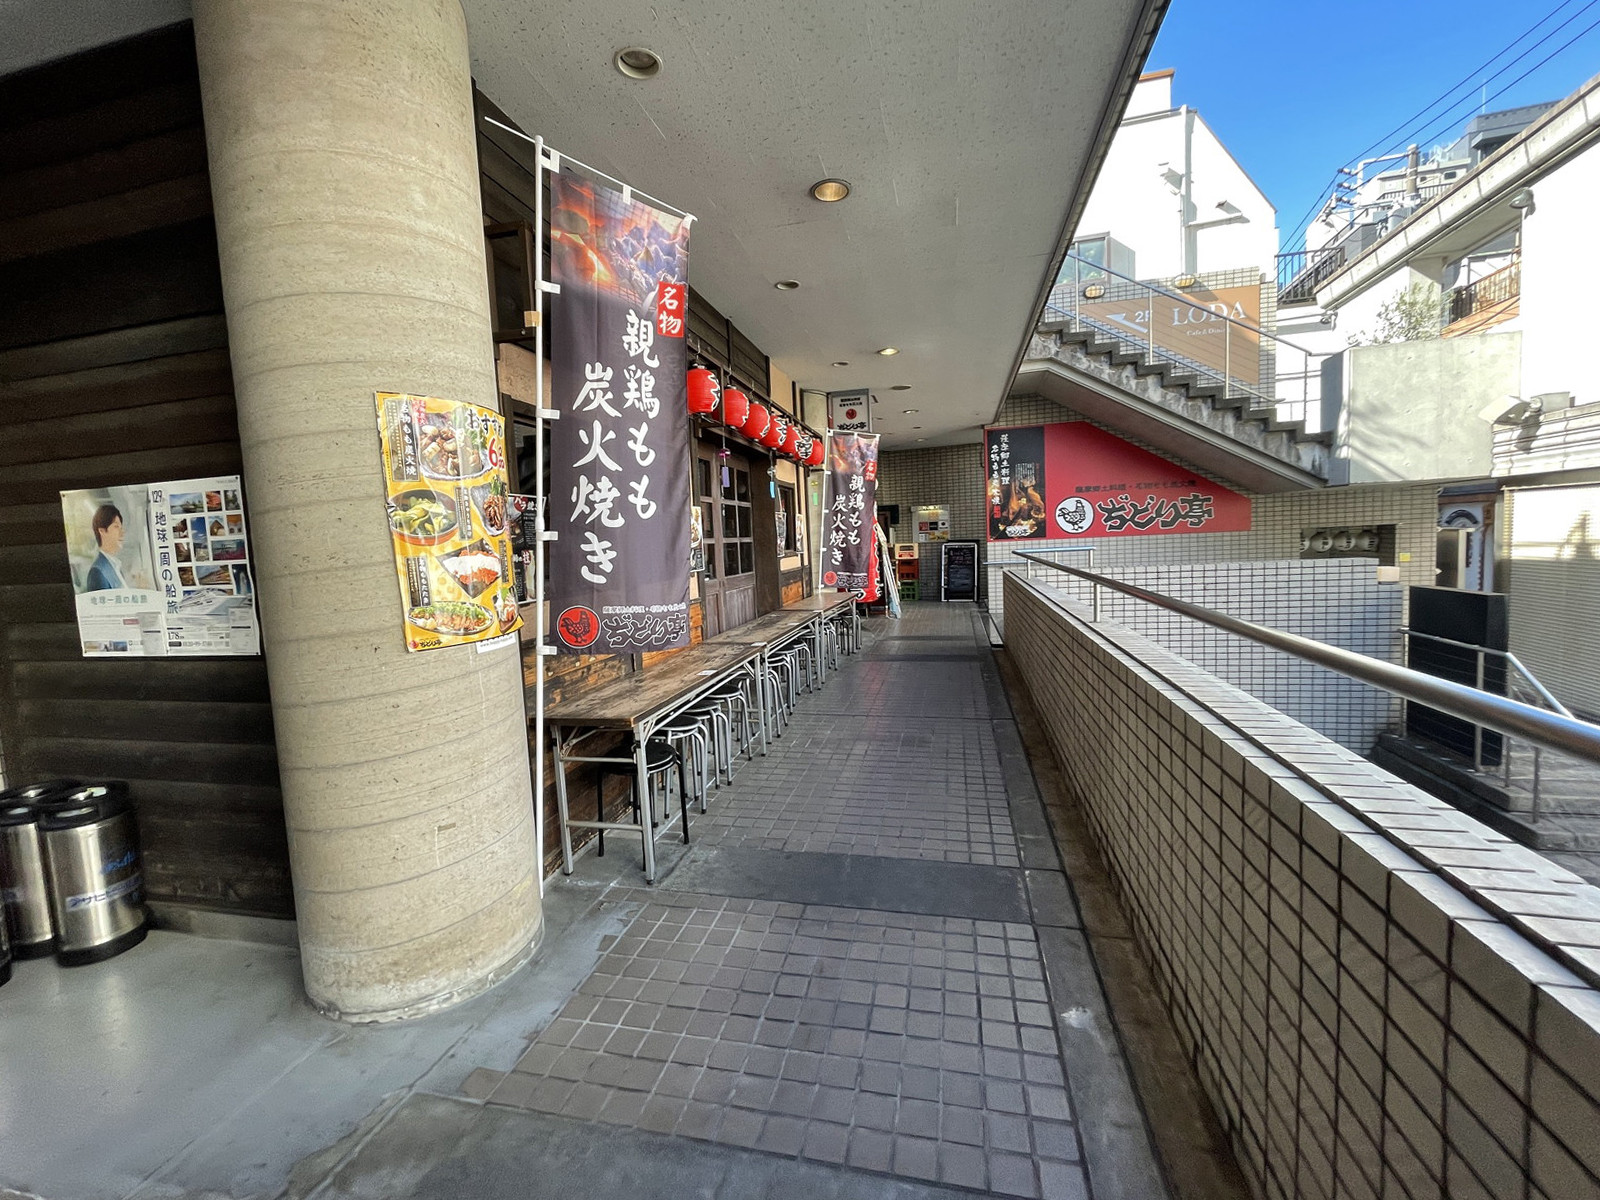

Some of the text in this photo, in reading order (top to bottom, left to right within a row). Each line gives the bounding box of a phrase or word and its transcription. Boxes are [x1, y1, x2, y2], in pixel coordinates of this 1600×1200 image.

[659, 286, 683, 335] 名物
[1172, 301, 1247, 326] LODA
[466, 408, 503, 438] おすすめ
[621, 308, 661, 520] 親鶏もも
[569, 361, 626, 585] 炭火焼き
[829, 494, 849, 565] 炭火焼き
[848, 474, 866, 545] 親鶏もも
[154, 511, 179, 614] 地球一周の船旅
